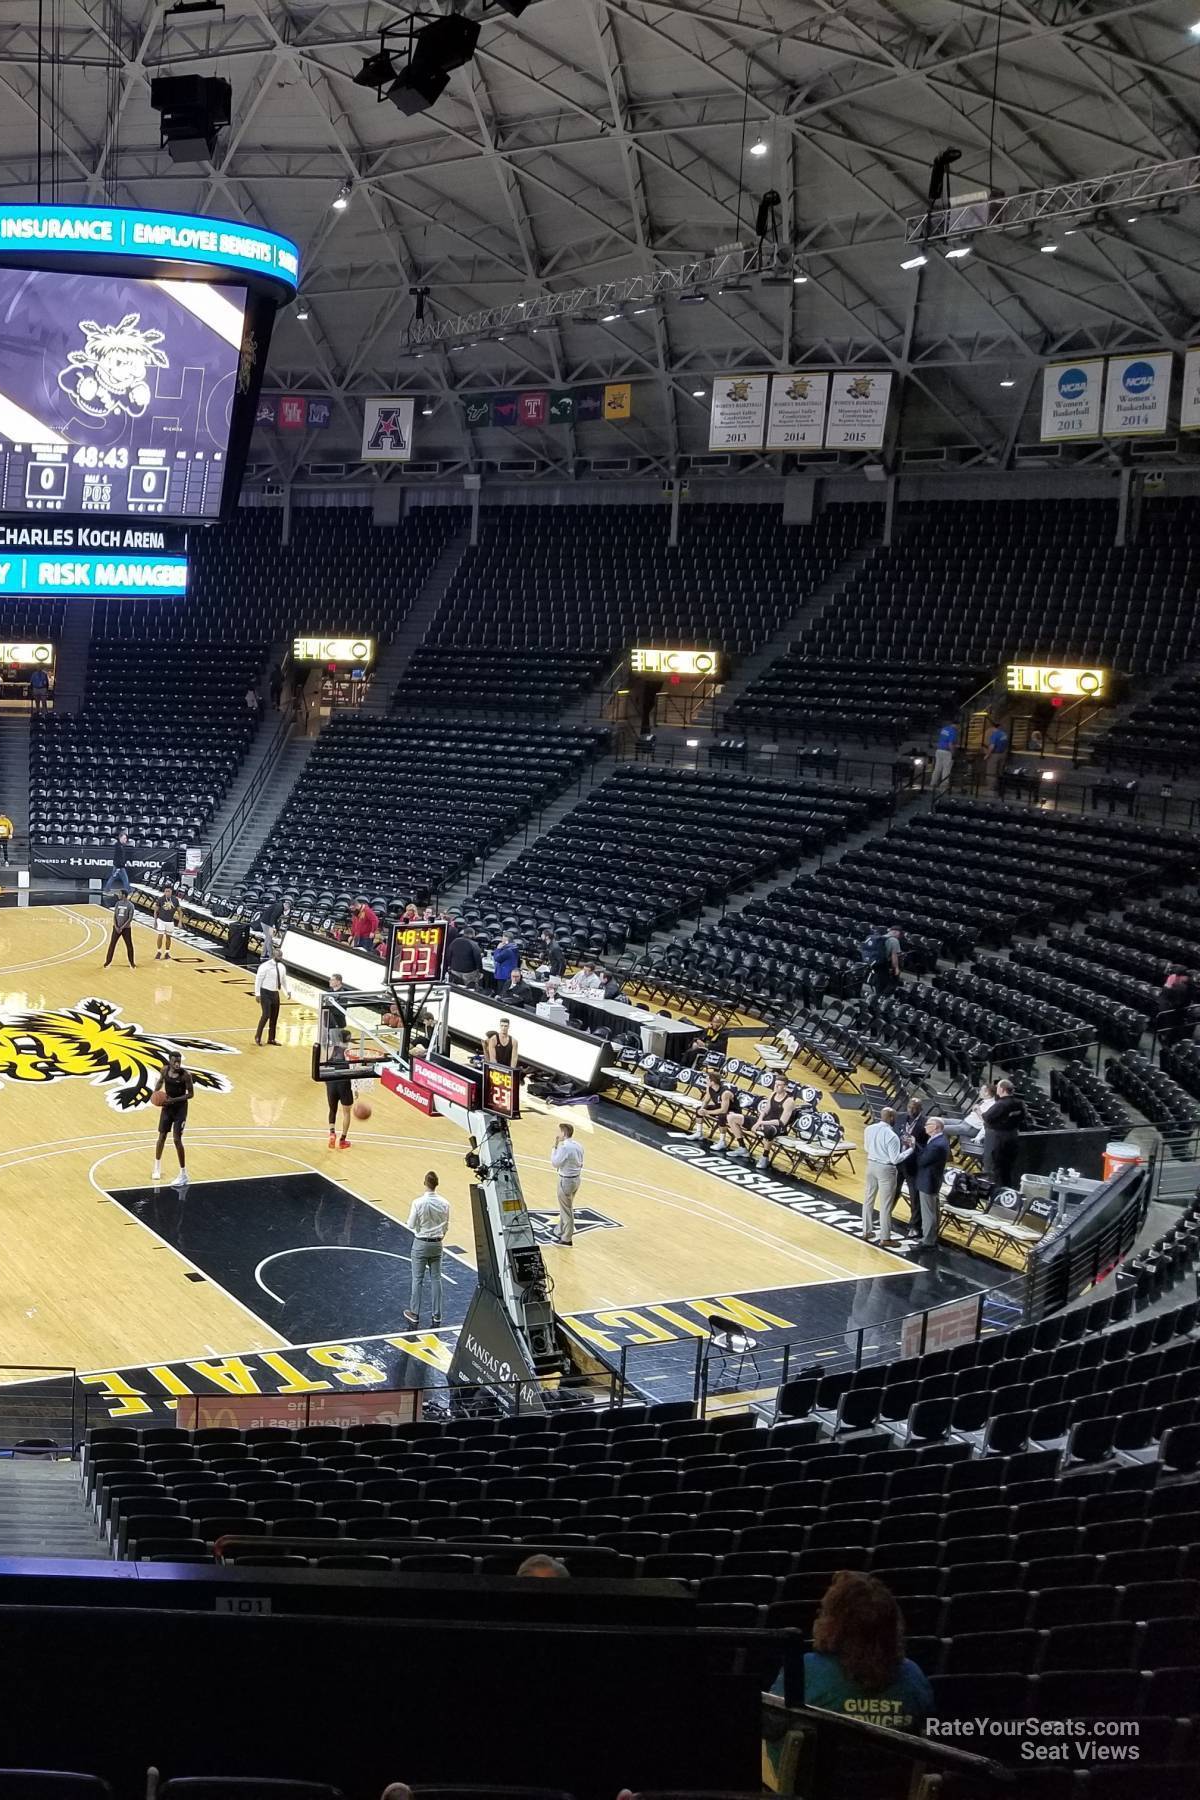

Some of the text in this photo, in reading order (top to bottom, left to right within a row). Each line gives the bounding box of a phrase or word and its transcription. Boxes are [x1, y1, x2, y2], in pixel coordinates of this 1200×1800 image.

[0, 219, 112, 242] INSURANCE
[133, 223, 218, 252] EMPLOYEE
[219, 233, 272, 263] BENEFITS
[1061, 382, 1088, 392] NCAA
[1125, 376, 1154, 386] NCAA
[1054, 400, 1089, 408] Women's
[1116, 402, 1157, 412] Basketball
[1052, 407, 1090, 417] Basketball
[1121, 414, 1148, 425] 2014
[1057, 420, 1083, 431] 2013
[725, 433, 747, 443] 2013
[784, 432, 806, 441] 2014
[843, 432, 867, 441] 2015
[40, 468, 55, 490] 0
[142, 472, 157, 493] 0
[83, 486, 112, 501] POS
[78, 528, 120, 547] KOCH
[123, 529, 165, 549] ARENA
[38, 562, 91, 586] RISK
[84, 858, 114, 867] UNDE
[125, 860, 166, 868] ARMOU
[396, 928, 439, 945] 48:43
[400, 947, 432, 976] 23
[415, 1064, 435, 1083] FLOOR
[442, 1077, 466, 1096] DECOR
[493, 1086, 511, 1111] 23
[465, 1334, 499, 1373] KANSAS
[78, 1344, 388, 1418] STATE
[225, 1600, 269, 1613] 101
[844, 1699, 902, 1714] GUEST
